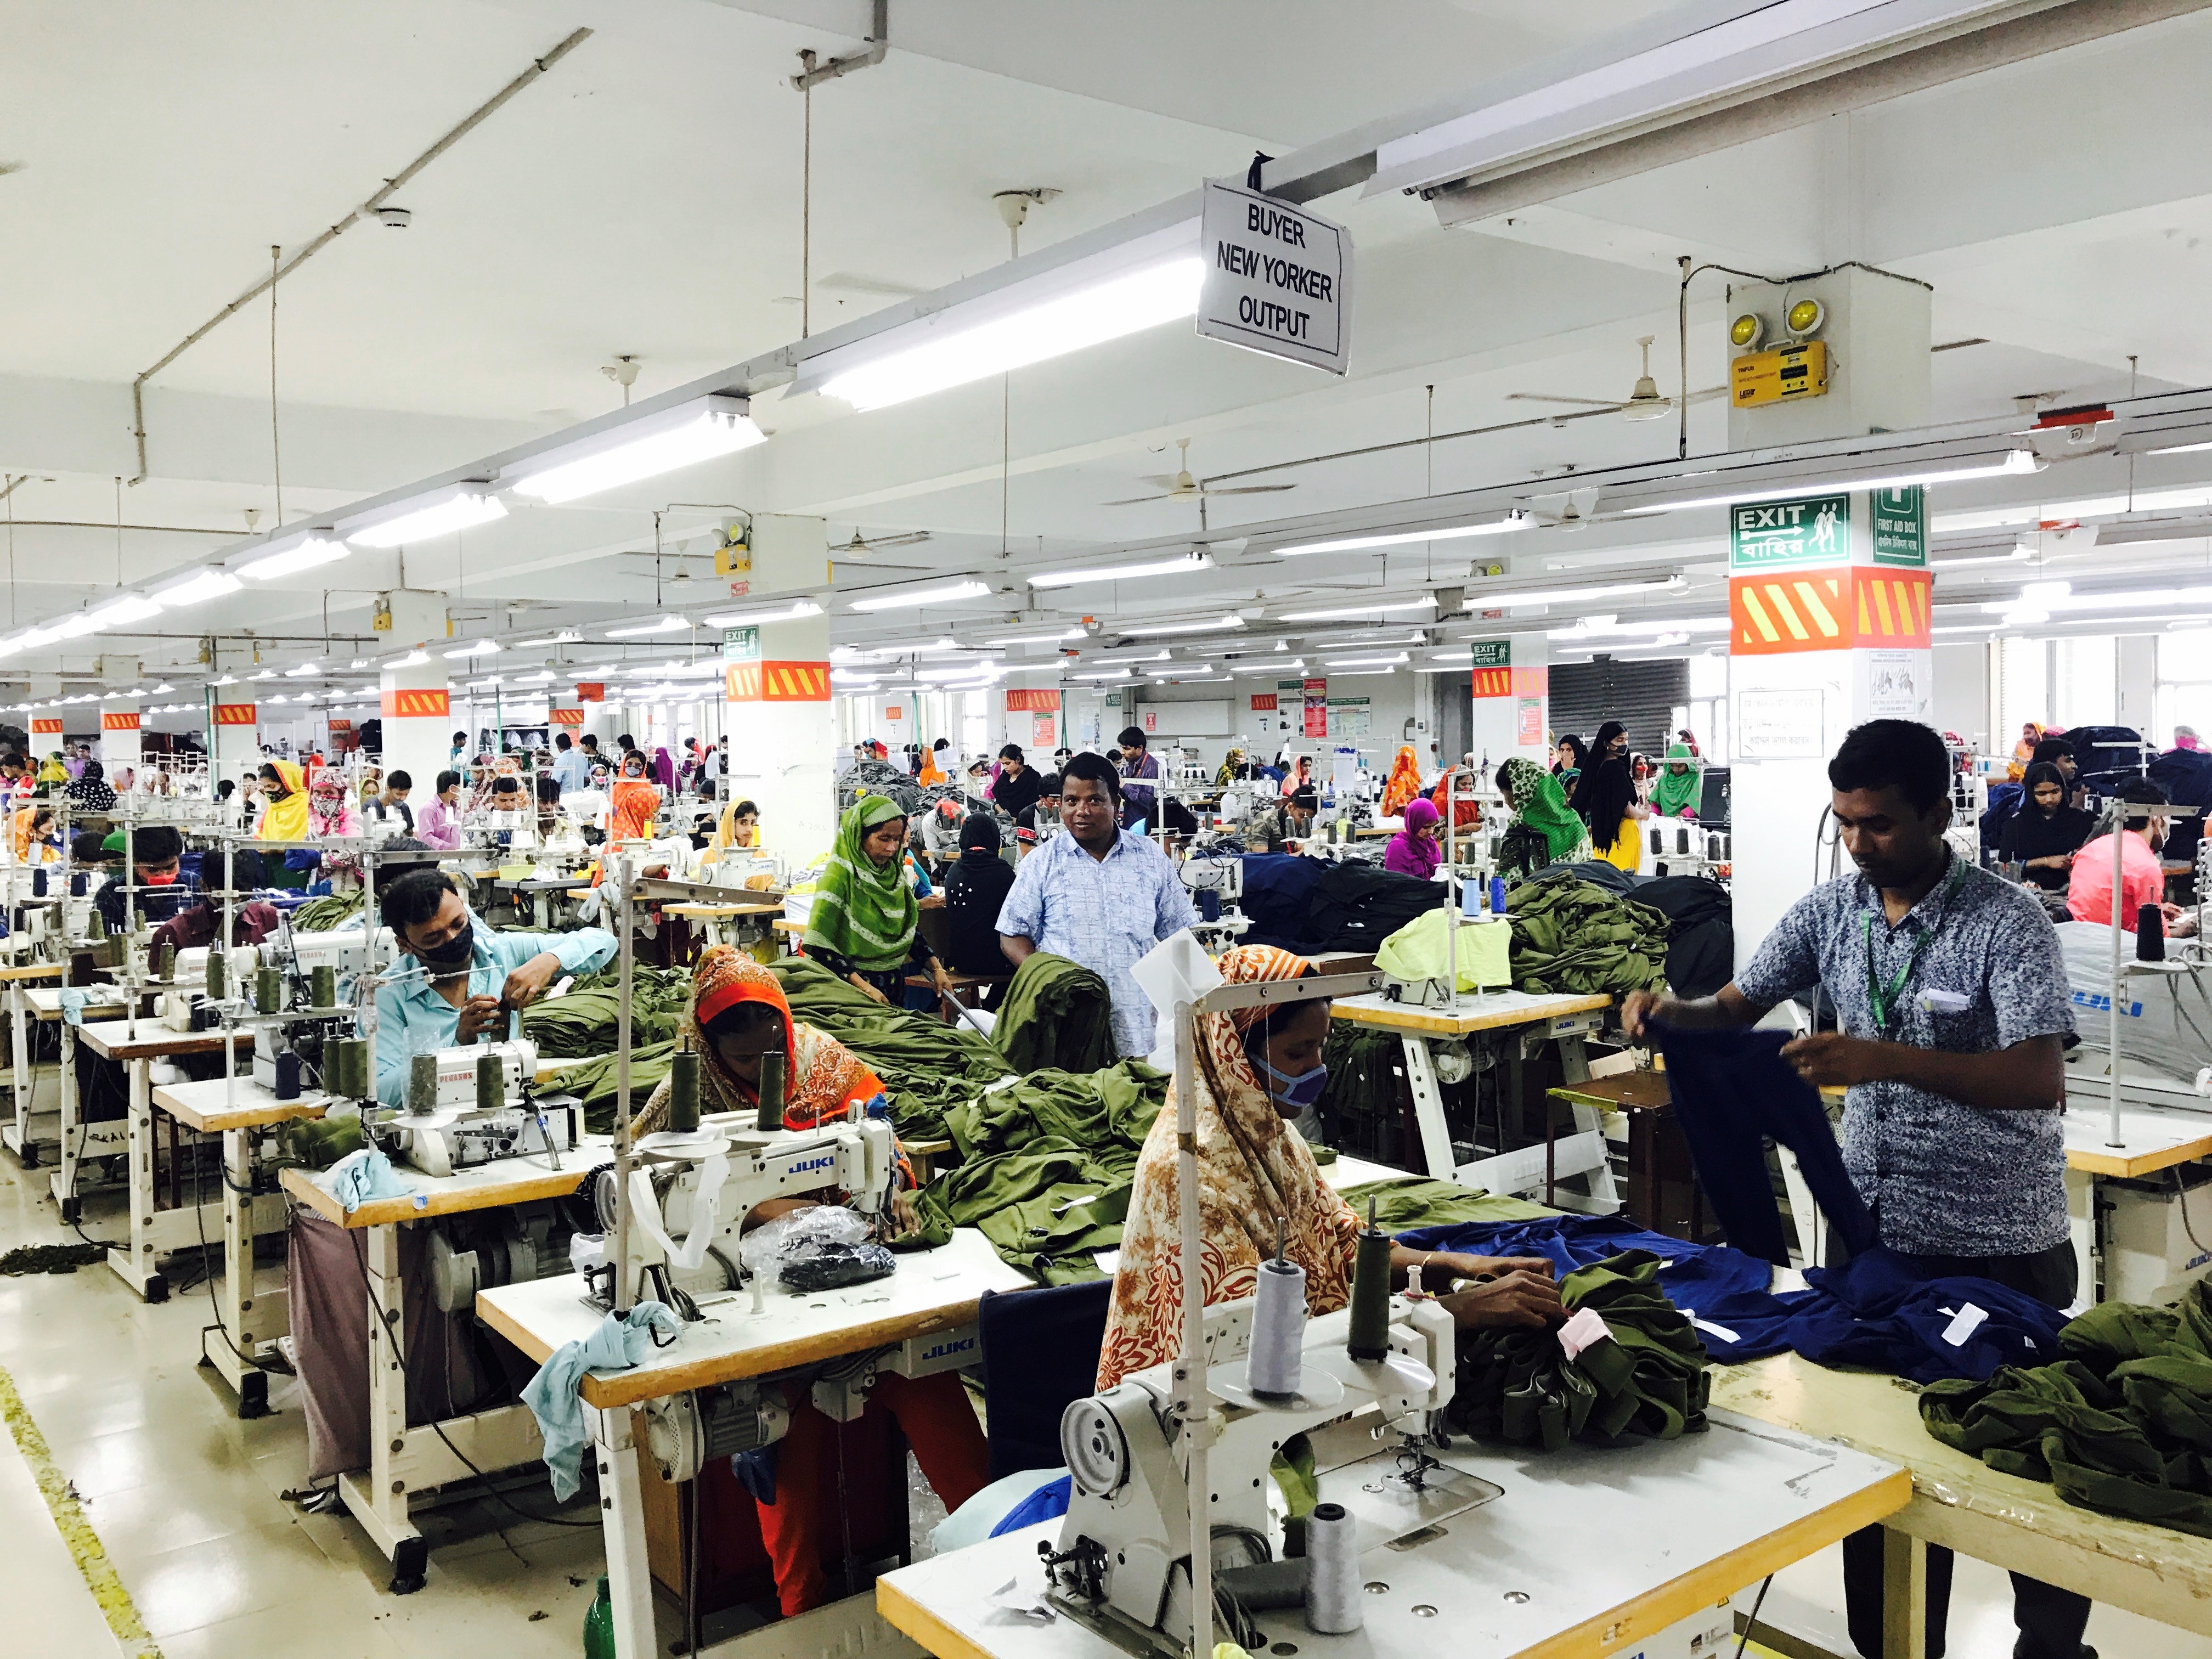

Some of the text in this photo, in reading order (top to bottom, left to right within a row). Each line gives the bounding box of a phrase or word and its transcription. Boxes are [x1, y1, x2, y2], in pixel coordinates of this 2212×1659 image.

[1248, 204, 1306, 249] BUYER
[1217, 240, 1332, 303] NEW YORKER
[1239, 295, 1310, 339] OUTPUT
[1739, 505, 1806, 529] EXIT
[1878, 518, 1916, 534] FIRST AID BOX
[1739, 537, 1805, 558] বাহির
[725, 630, 747, 641] EXIT
[1474, 645, 1496, 653] EXIT
[1475, 656, 1496, 664] বাহির
[1556, 1020, 1575, 1030] JUKI
[440, 1071, 472, 1082] PEGASUS
[788, 1155, 834, 1173] JUKI
[922, 1338, 974, 1359] JUKI
